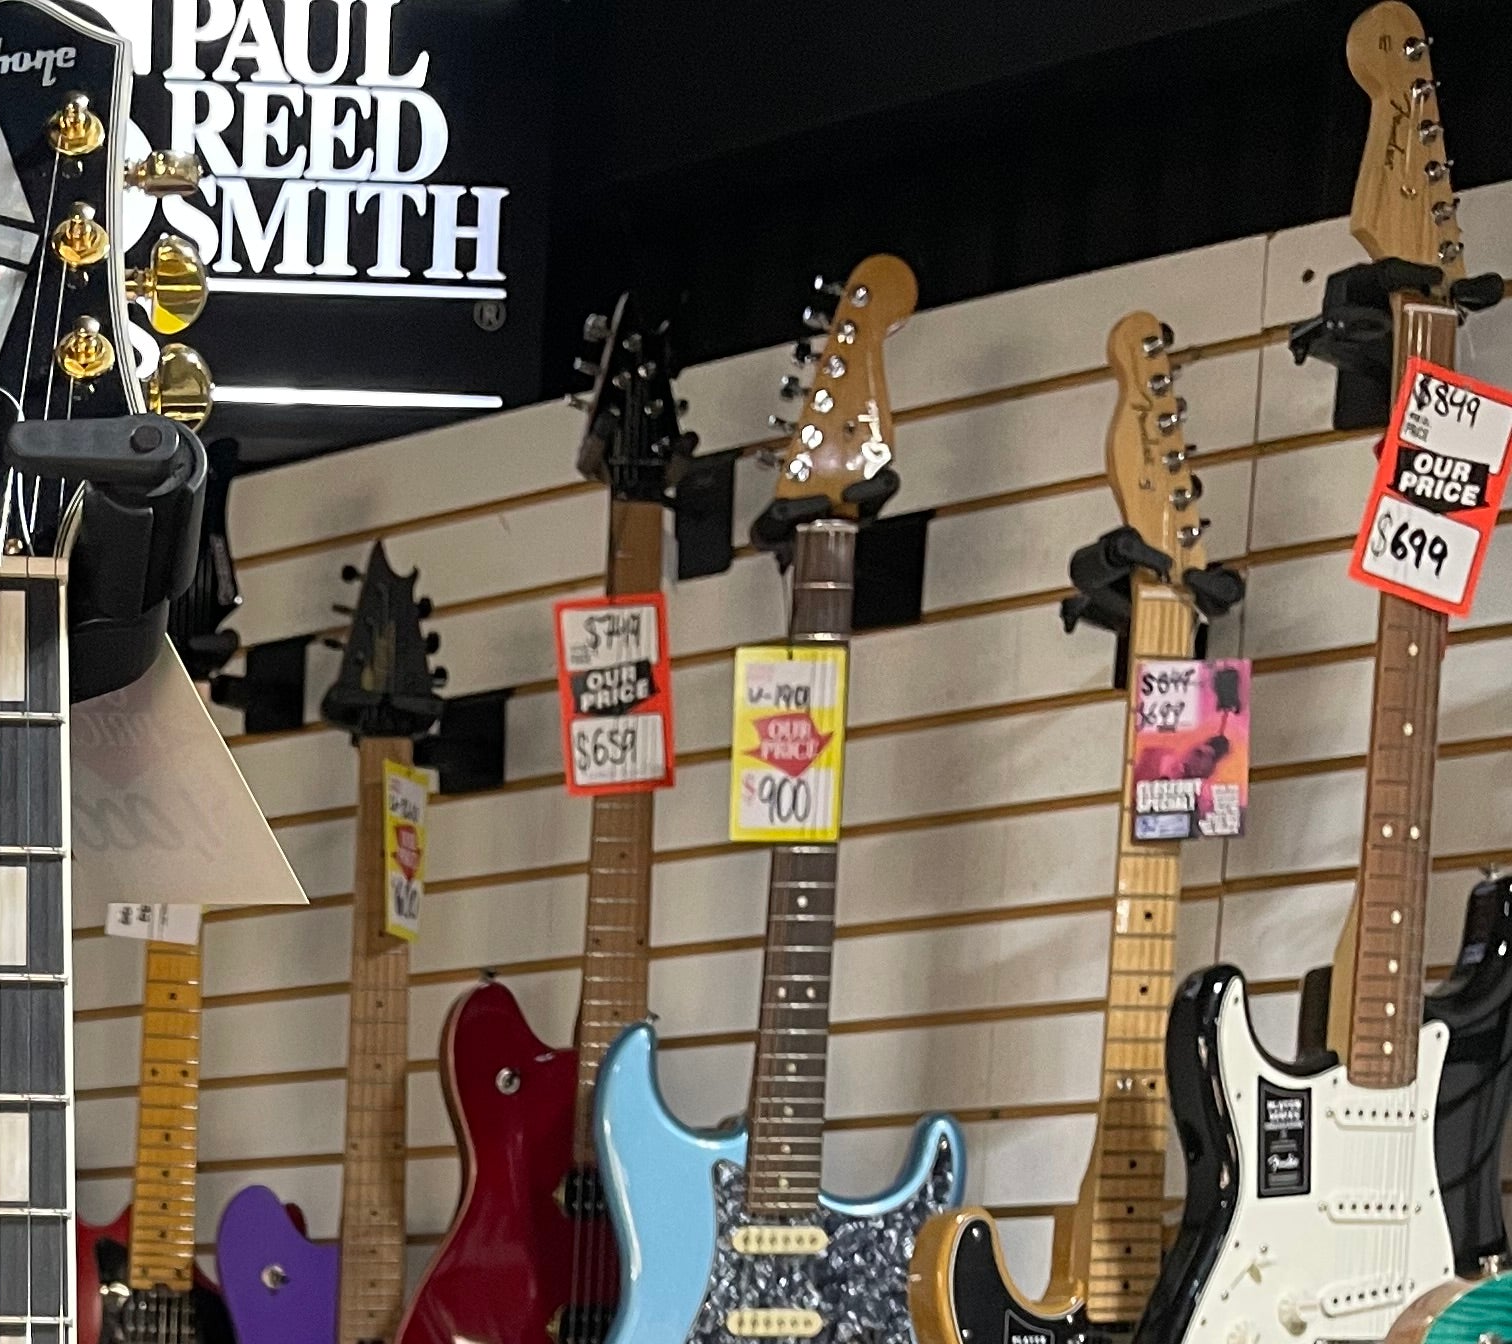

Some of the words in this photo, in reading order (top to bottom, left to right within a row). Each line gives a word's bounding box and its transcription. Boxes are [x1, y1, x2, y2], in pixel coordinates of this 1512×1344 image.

[163, 0, 430, 88] PAUL
[164, 80, 449, 182] REED
[161, 174, 511, 281] SMITH
[1399, 471, 1481, 508] PRICE
[1413, 452, 1473, 484] OUR
[1371, 512, 1449, 578] $699
[580, 679, 650, 712] PRICE
[587, 665, 637, 690] OUR
[743, 774, 811, 824] $900
